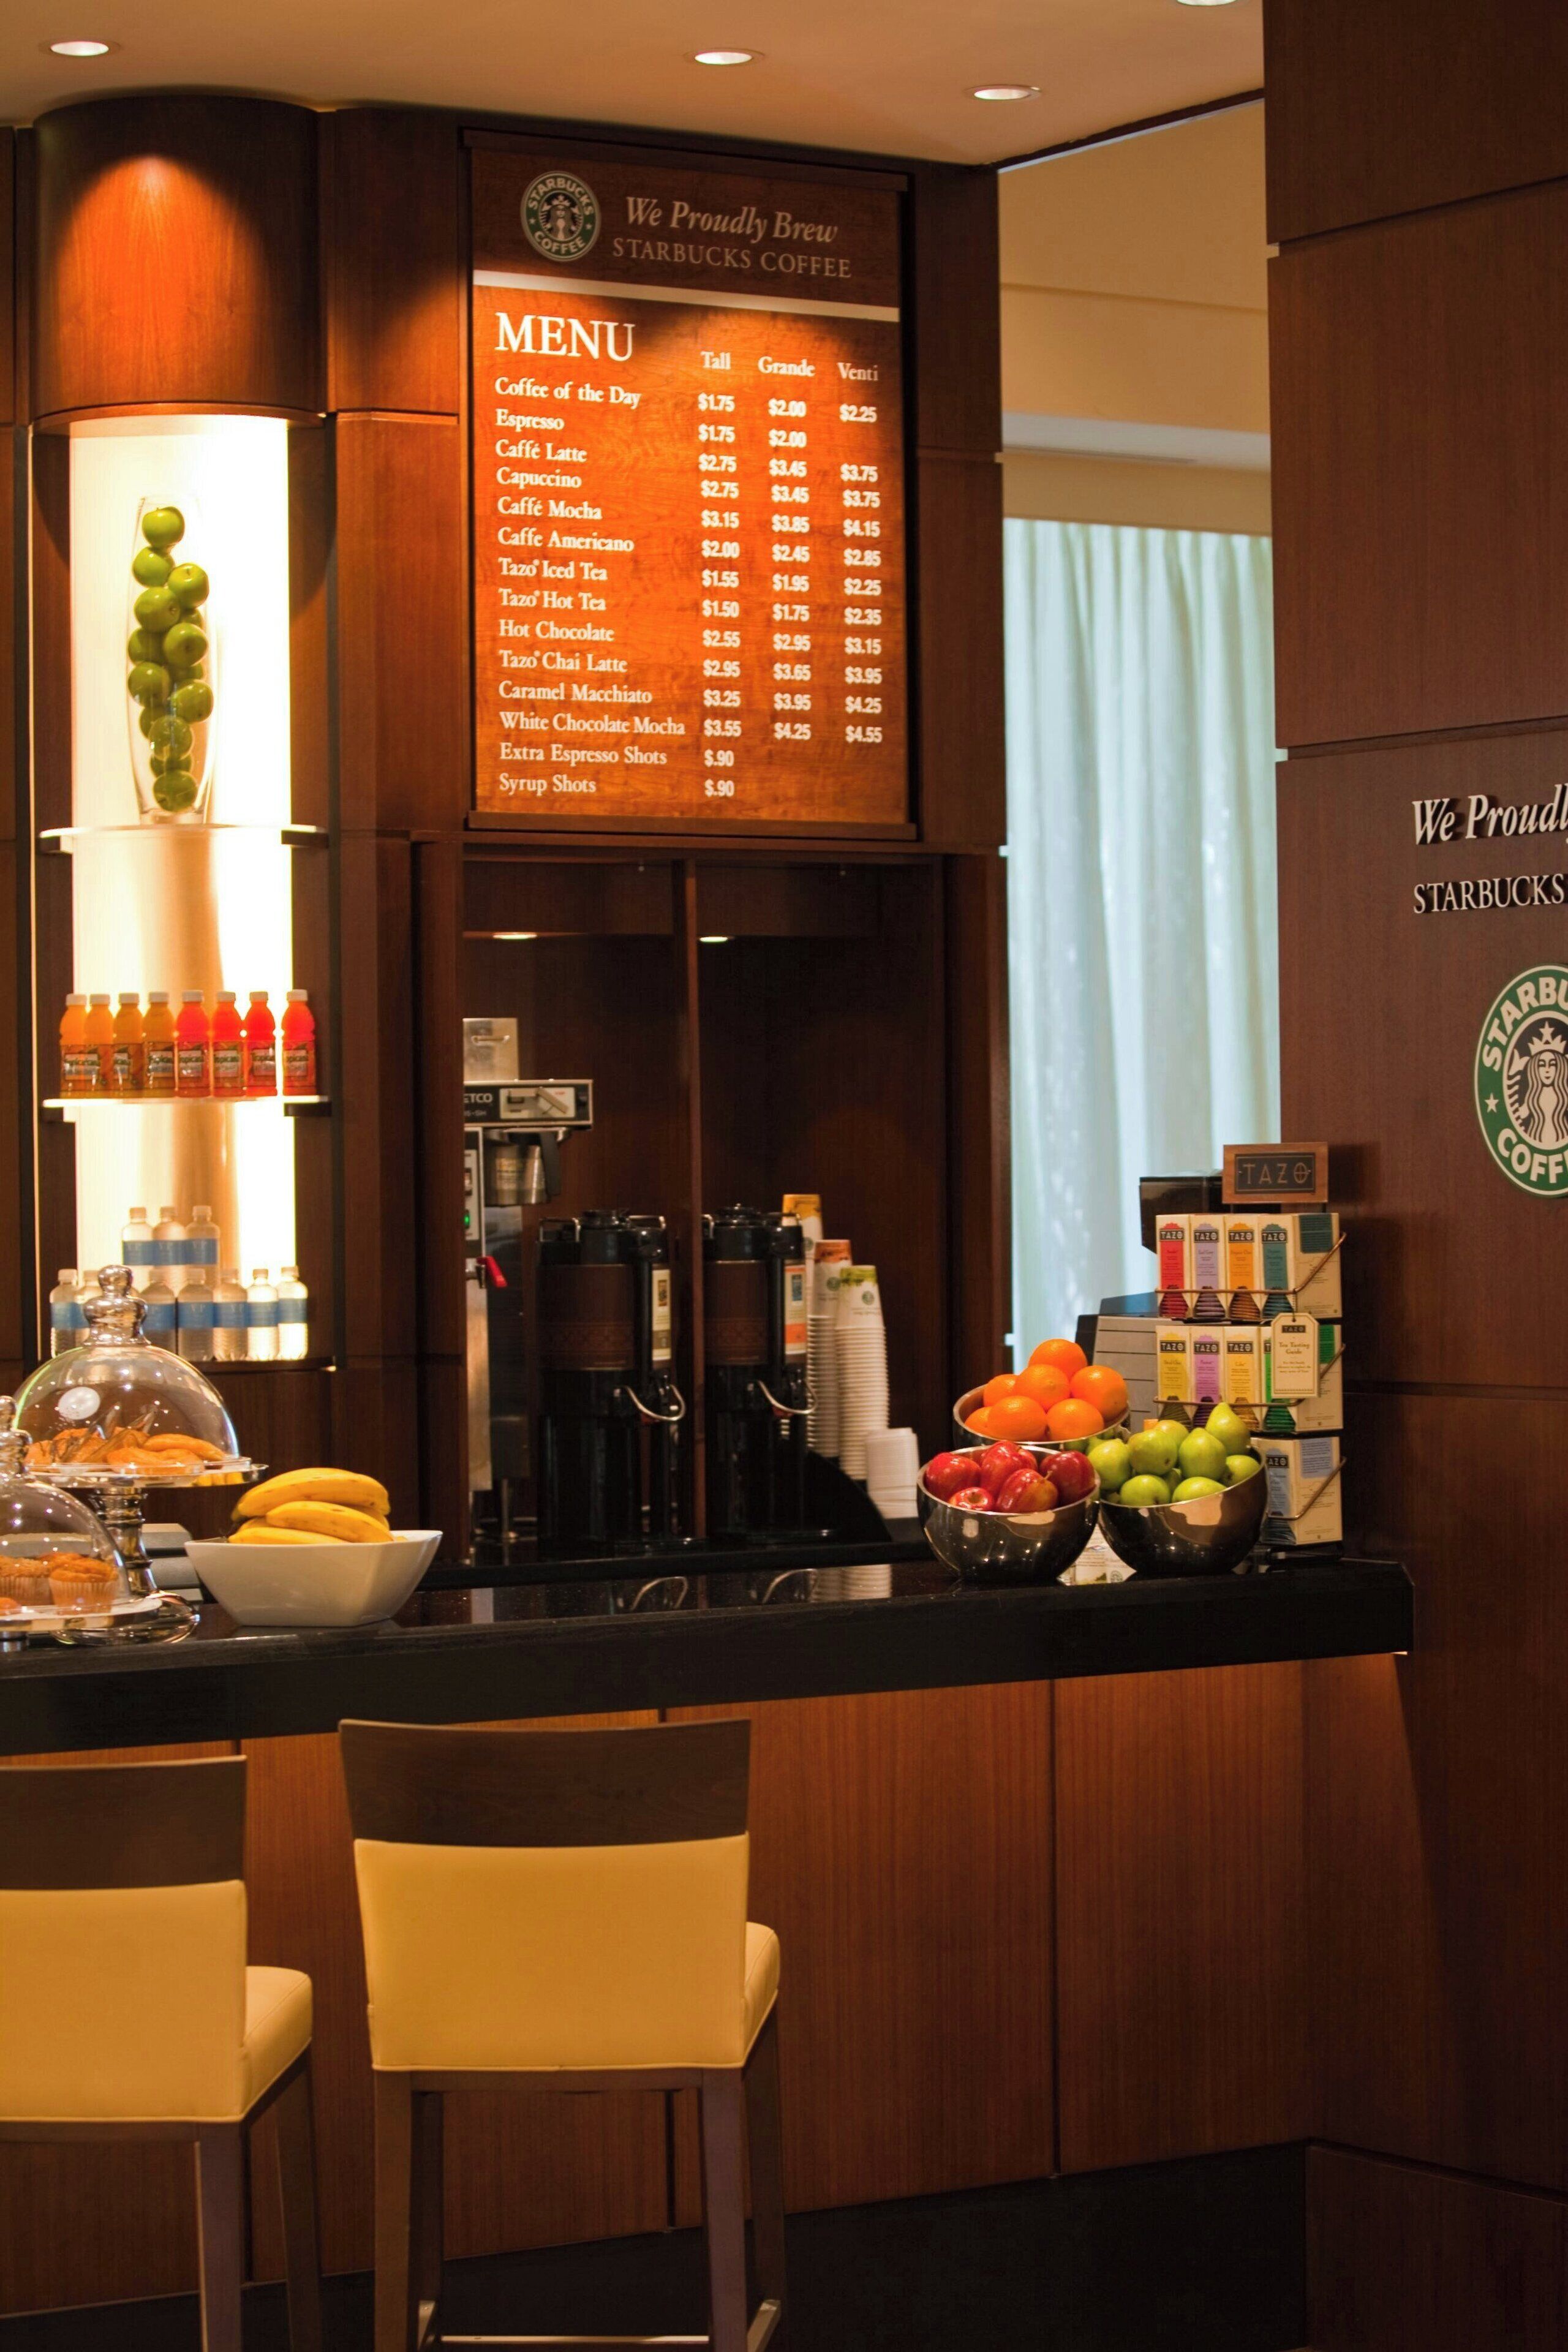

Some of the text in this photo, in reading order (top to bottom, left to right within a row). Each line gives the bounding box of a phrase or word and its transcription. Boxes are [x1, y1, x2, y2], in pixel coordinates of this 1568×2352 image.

[528, 177, 594, 215] STARBUCKS
[626, 196, 839, 244] We Proudly Brew
[534, 230, 586, 254] COFFEE
[612, 237, 851, 278] STARBUCKS COFFEE
[495, 312, 635, 361] MENU
[700, 351, 878, 381] Tall Grande Venti
[495, 377, 876, 423] Coffee of the Day $1.75 $2.00 $2.25
[496, 408, 807, 448] Espresso $1.75 $2.00
[496, 439, 878, 482] Caffé Latte $2.75 $3.45 $3.75
[496, 466, 880, 508] Capuccino $2.75 $3.45 $3.75
[497, 496, 880, 537] Caffé Mocha $3.15 $3.85 $4.15
[548, 530, 635, 552] Americano
[701, 539, 740, 558] $2.00
[772, 543, 810, 562] $2.45
[843, 548, 881, 567] $2.85
[542, 560, 575, 579] Iced
[579, 562, 608, 581] Tea
[702, 568, 739, 588] $1.55
[772, 573, 810, 592] $1.95
[844, 578, 881, 596] $2.25
[543, 590, 573, 609] Hot
[578, 592, 606, 611] Tea
[702, 599, 740, 618] $1.50
[773, 603, 810, 622] $1.75
[845, 607, 882, 625] $2.35
[499, 619, 881, 655] Hot Chocolate $2.55 $2.95 $3.15
[541, 651, 580, 670] Chai
[587, 654, 627, 673] Latte
[703, 659, 741, 677] $2.95
[774, 663, 811, 681] $3.65
[845, 666, 882, 684] $3.95
[499, 680, 882, 714] Caramel Macchiato $3.25 $3.95 $4.25
[499, 711, 883, 743] White Chocolate Mocha $3.55 $4.25 $4.55
[500, 742, 734, 767] Extra Espresso Shots $.90
[499, 772, 734, 797] Syrup Shots $.90
[1411, 783, 1568, 845] We Proudl
[1413, 872, 1565, 914] STARBUCKS
[1243, 1162, 1309, 1185] TAZO
[1161, 1230, 1184, 1239] TAZO
[1195, 1232, 1218, 1241] TAZO
[1229, 1232, 1253, 1242] TAZO
[1262, 1232, 1286, 1242] TAZO
[1161, 1343, 1184, 1351] TAZO
[1195, 1344, 1218, 1352] TAZO
[1227, 1343, 1251, 1352] TAZO
